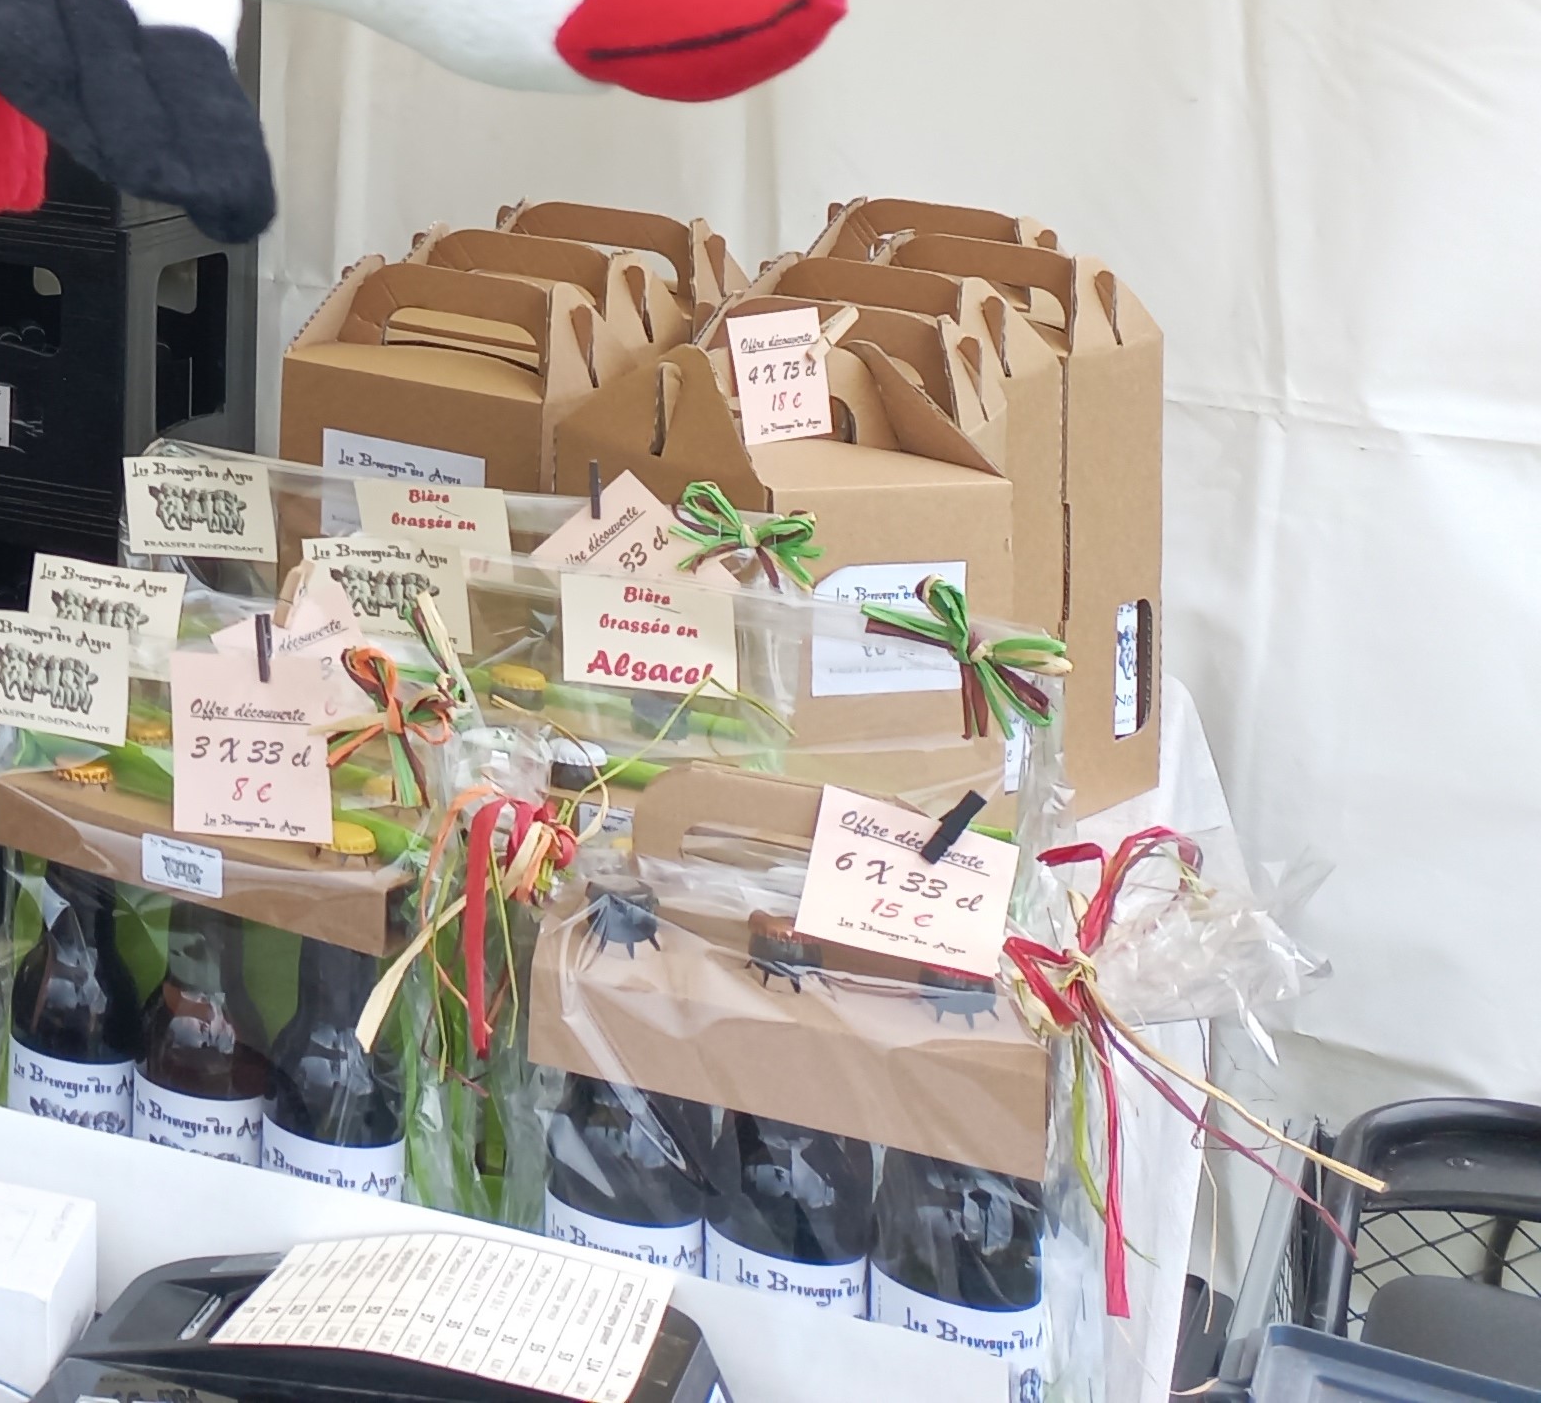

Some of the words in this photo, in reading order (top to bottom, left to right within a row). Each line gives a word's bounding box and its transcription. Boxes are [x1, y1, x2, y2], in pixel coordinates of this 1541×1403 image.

[741, 338, 764, 353] Offre
[769, 333, 812, 346] découverte
[748, 366, 758, 384] 4
[763, 364, 776, 384] X
[783, 361, 800, 380] 75
[805, 360, 817, 376] cl
[772, 391, 787, 411] 18
[338, 449, 354, 466] Les
[358, 453, 407, 478] Breuvages
[405, 462, 424, 478] des
[429, 468, 461, 485] Anges
[588, 506, 639, 553] découverte
[619, 542, 647, 573] 33
[653, 526, 669, 551] cl
[624, 586, 671, 605] Bière
[600, 613, 670, 634] brassée
[676, 626, 698, 638] en
[586, 650, 713, 685] Alsace!
[190, 698, 229, 721] Offre
[234, 703, 308, 722] découverte
[190, 736, 211, 759] 3
[219, 737, 240, 764] X
[247, 740, 284, 764] 33
[292, 745, 311, 767] cl
[232, 778, 249, 801] 8
[256, 782, 272, 803] €
[841, 810, 889, 837] Offre
[894, 831, 985, 870] décverte
[835, 852, 858, 871] 6
[865, 859, 894, 885] X
[899, 871, 948, 898] 33
[955, 894, 984, 912] cl
[870, 898, 903, 919] 15
